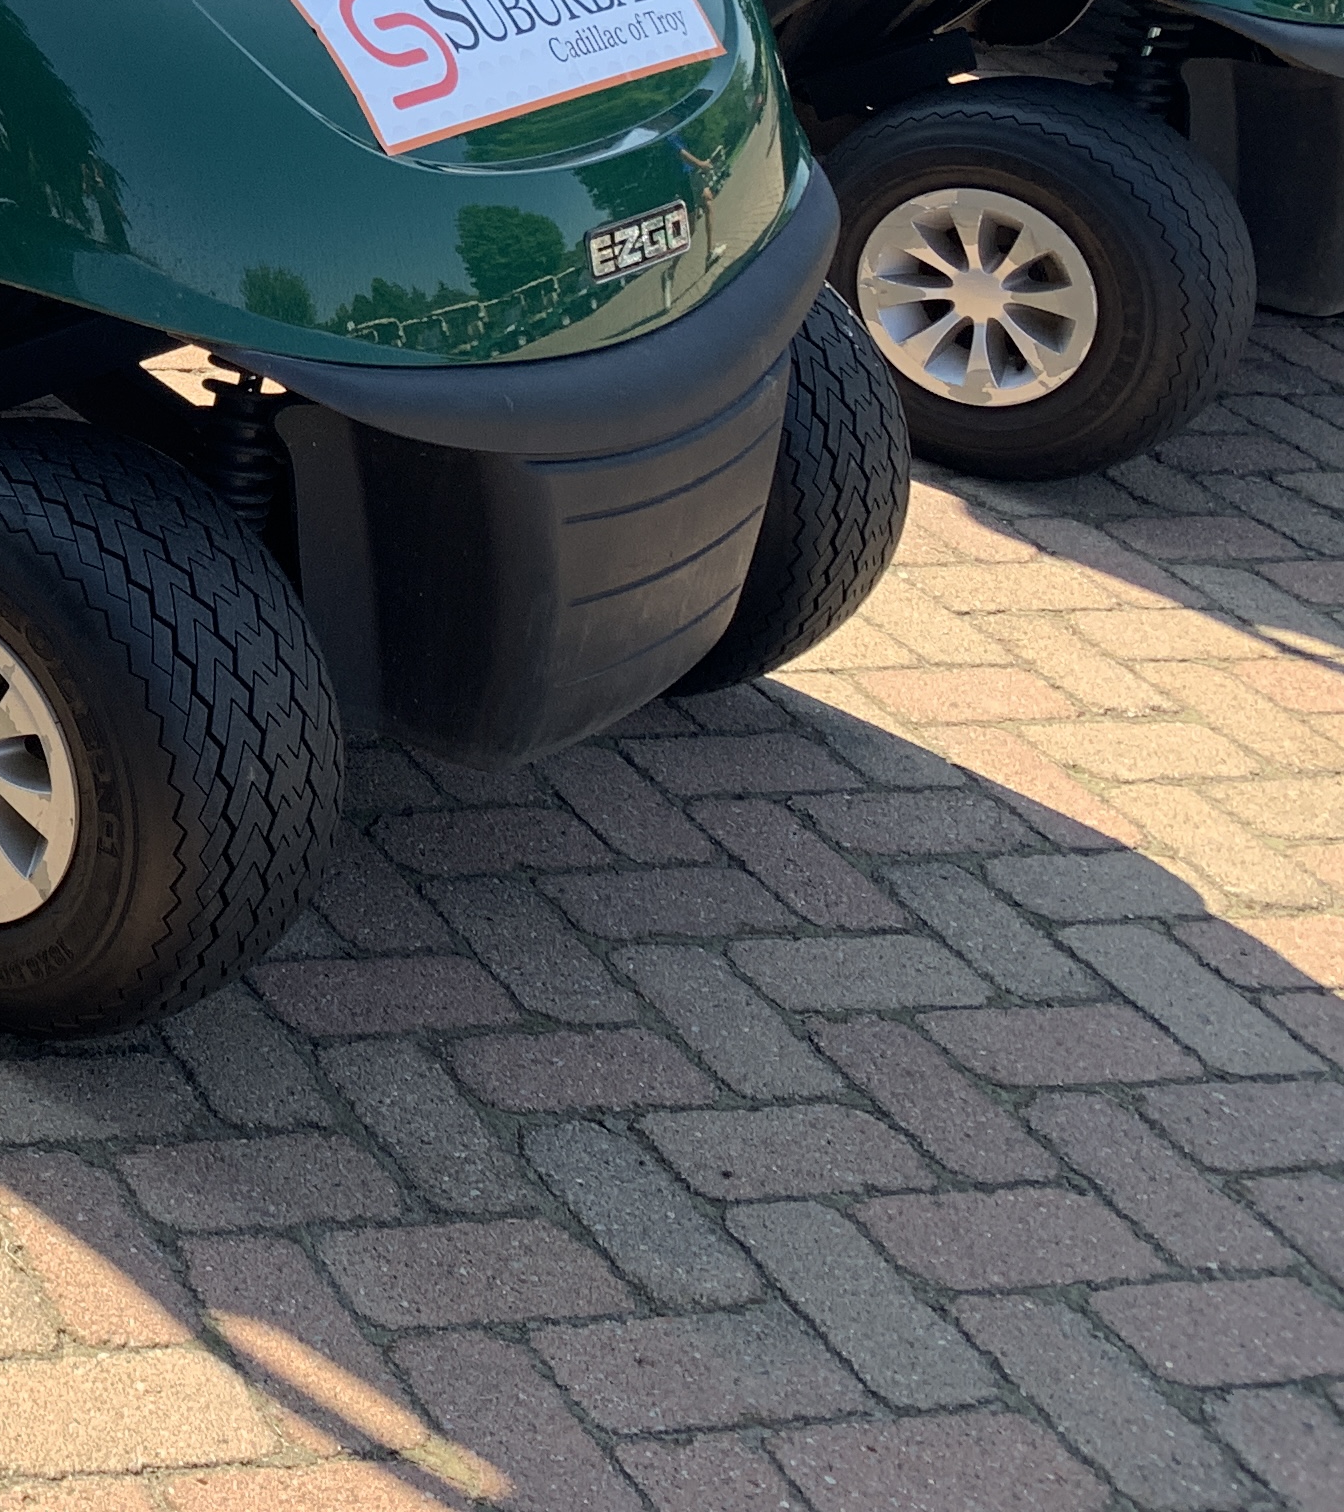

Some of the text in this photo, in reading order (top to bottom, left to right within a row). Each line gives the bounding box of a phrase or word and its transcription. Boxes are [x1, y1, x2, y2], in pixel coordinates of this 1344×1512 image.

[548, 8, 689, 63] Cadillac of Troy
